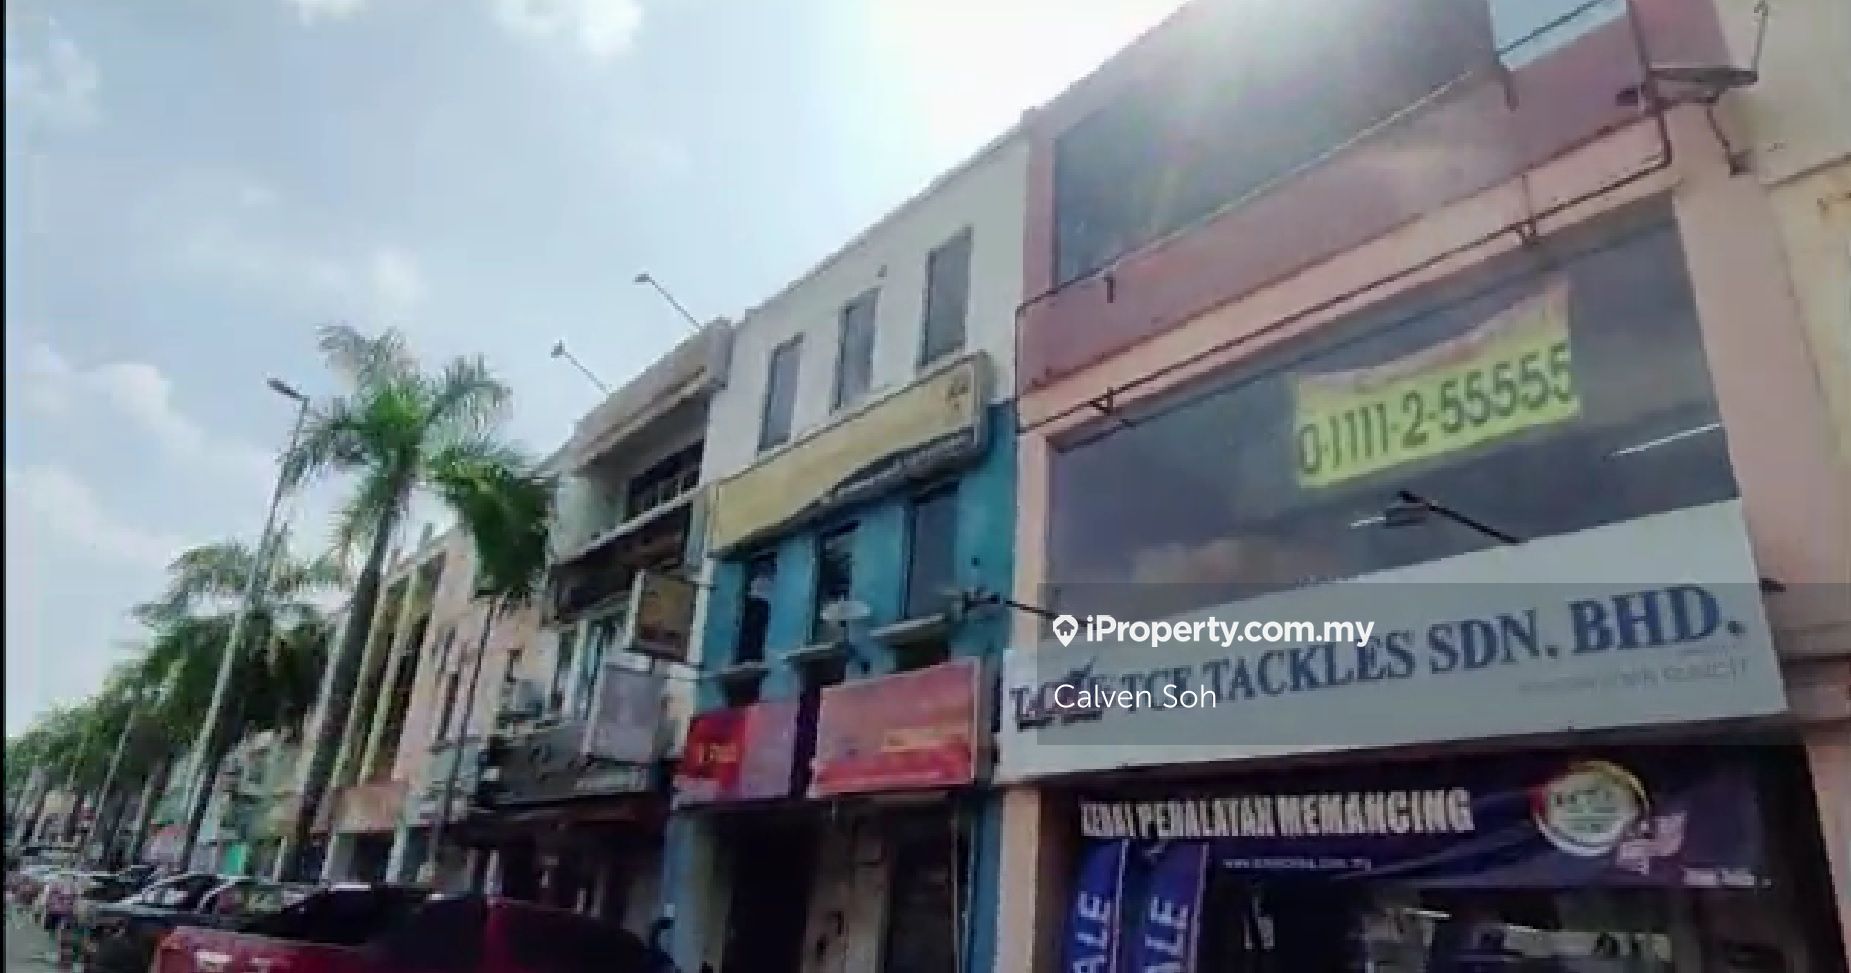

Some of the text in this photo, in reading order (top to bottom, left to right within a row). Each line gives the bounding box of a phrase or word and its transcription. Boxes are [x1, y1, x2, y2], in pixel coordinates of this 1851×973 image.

[1203, 630, 1416, 703] TACKLES
[1428, 608, 1558, 675] SDN.
[1569, 584, 1746, 656] BHD.
[1277, 787, 1475, 837] MEMANCING
